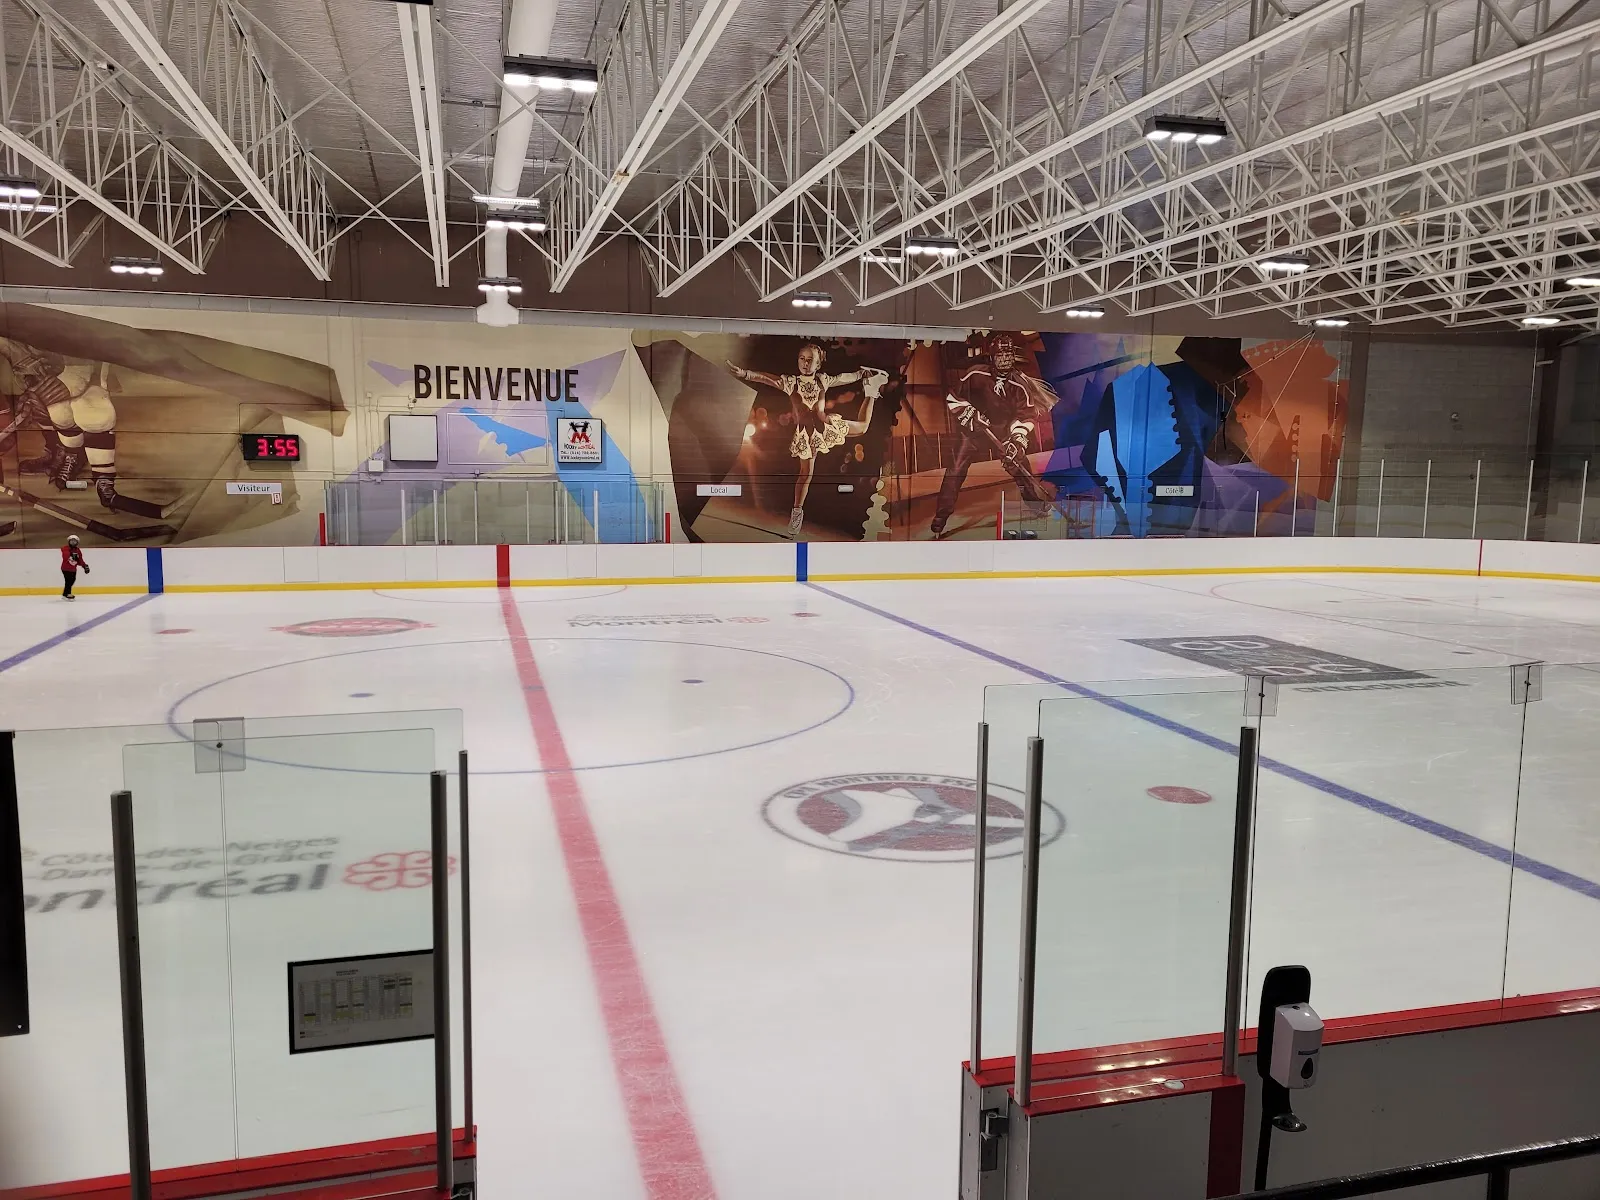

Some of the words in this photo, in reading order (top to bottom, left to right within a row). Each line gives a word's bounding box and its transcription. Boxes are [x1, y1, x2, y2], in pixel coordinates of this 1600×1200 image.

[414, 364, 578, 402] BIENVENUE
[257, 438, 298, 457] 3:55
[237, 484, 270, 492] Visiteur
[710, 486, 728, 494] Local
[815, 775, 931, 787] MONTREAL
